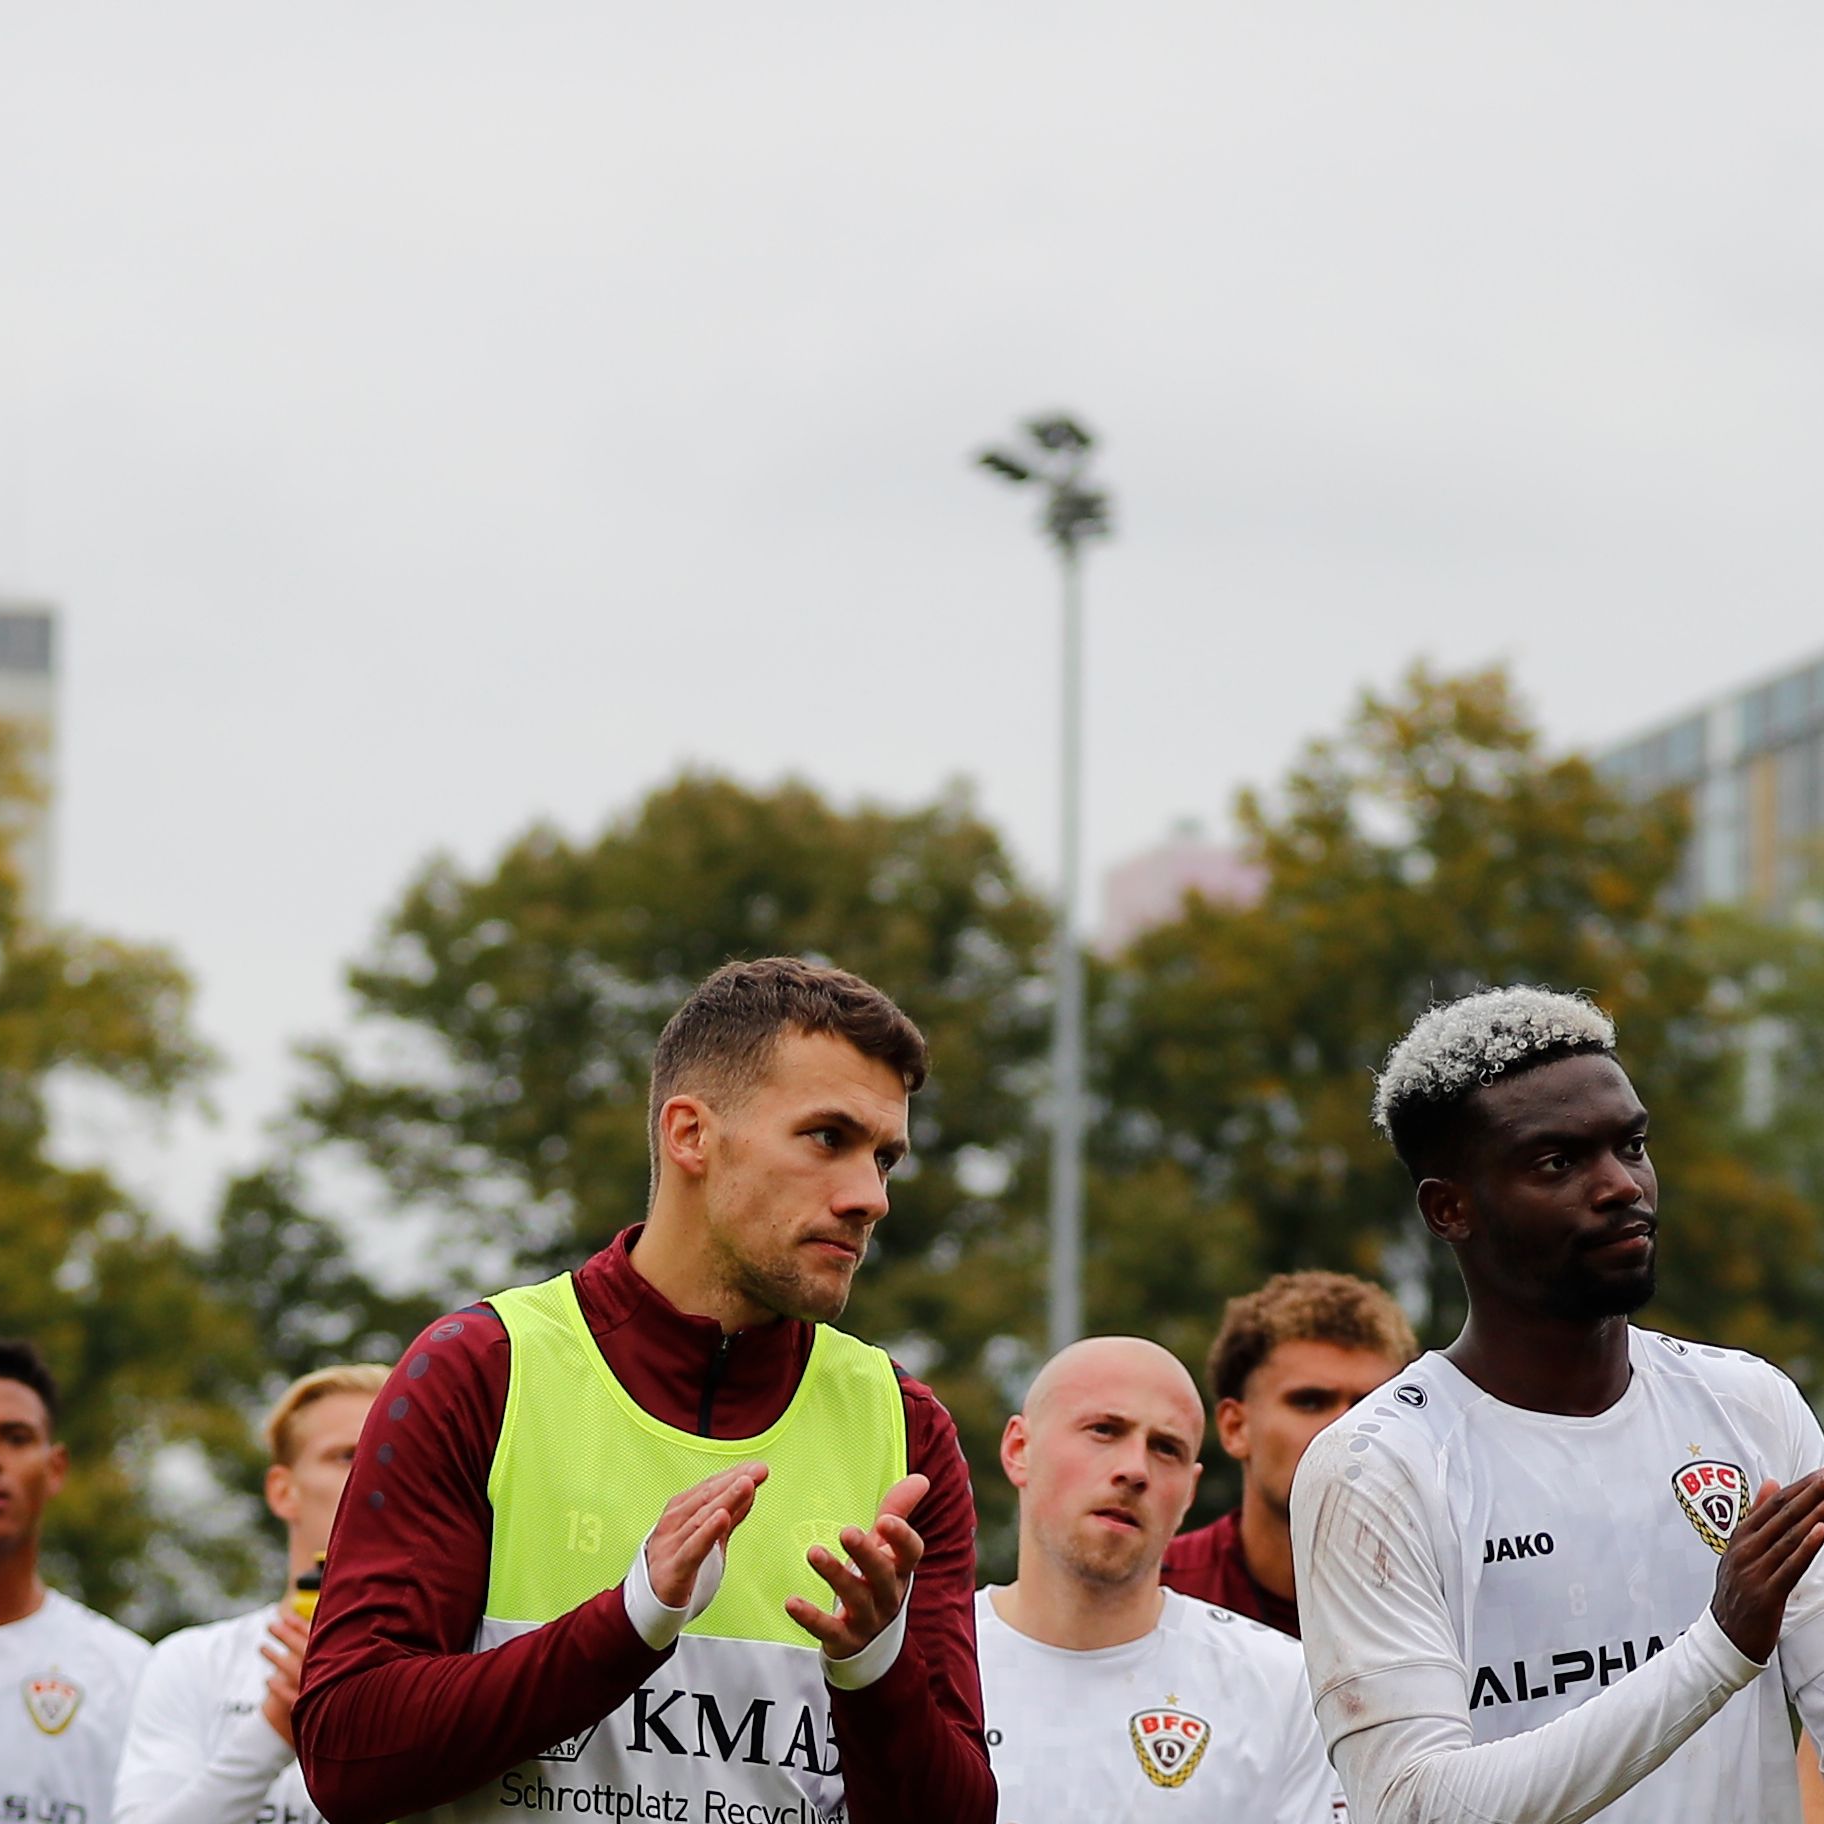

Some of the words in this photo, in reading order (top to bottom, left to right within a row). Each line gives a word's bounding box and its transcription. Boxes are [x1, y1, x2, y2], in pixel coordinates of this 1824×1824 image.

[1681, 1467, 1736, 1496] BFC
[1483, 1532, 1554, 1564] JAKO
[1141, 1715, 1202, 1740] BFC
